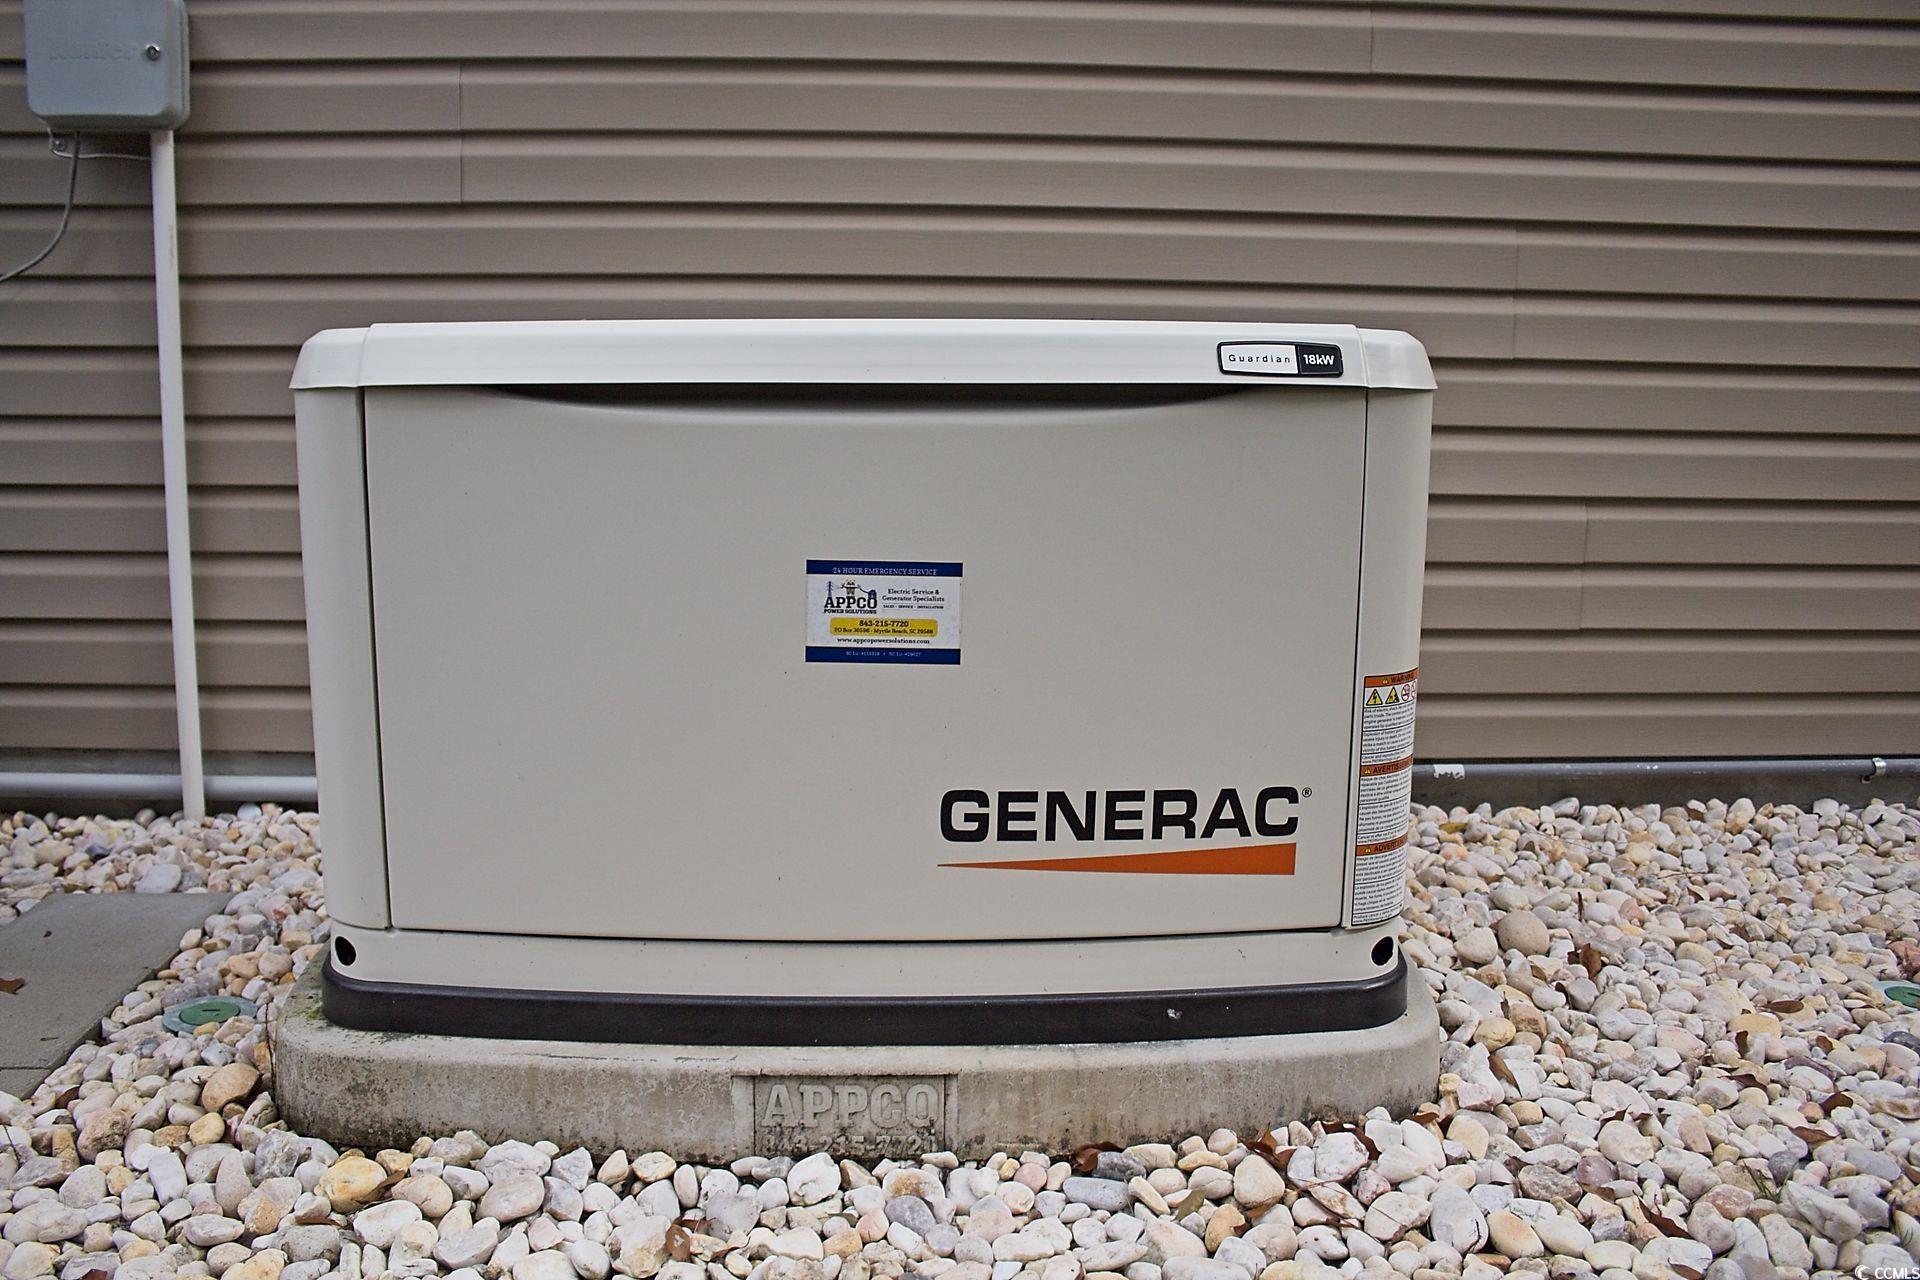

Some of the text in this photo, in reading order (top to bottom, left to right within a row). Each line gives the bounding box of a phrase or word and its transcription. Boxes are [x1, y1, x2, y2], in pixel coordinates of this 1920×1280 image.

[1228, 354, 1335, 366] Guardian 18kW
[824, 596, 877, 609] APPCO
[940, 786, 1300, 842] GENERAC
[760, 1084, 939, 1128] APPCO
